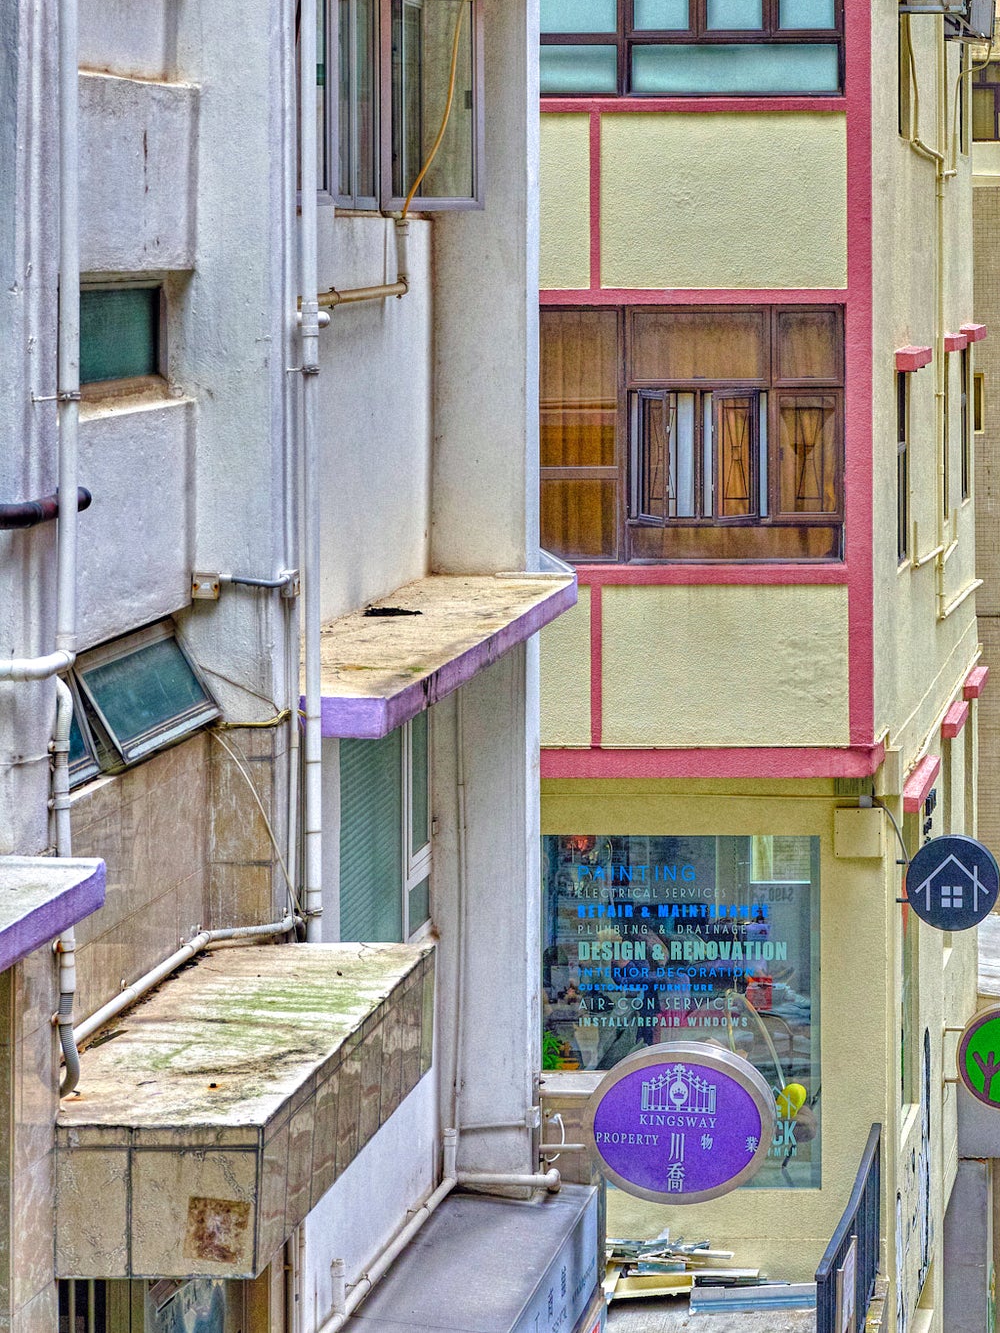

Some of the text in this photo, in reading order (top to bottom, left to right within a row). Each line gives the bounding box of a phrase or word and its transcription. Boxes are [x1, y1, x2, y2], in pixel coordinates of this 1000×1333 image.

[577, 865, 697, 881] PAINTING
[577, 887, 727, 899] ELECTRICAL SERVICES
[577, 904, 769, 918] REPAIR & MAINTENANCE
[577, 924, 747, 934] PLUMBING & DRAINAGE
[578, 941, 787, 960] DESIGN & RENOVATION
[578, 967, 755, 978] INTERIOR DECORATION
[578, 997, 735, 1010] AIR-CON SERVICE
[578, 1016, 748, 1027] INSTALL/REPAIR WINDOWS
[639, 1114, 718, 1129] KINGSWAY
[596, 1131, 659, 1146] PROPERTY
